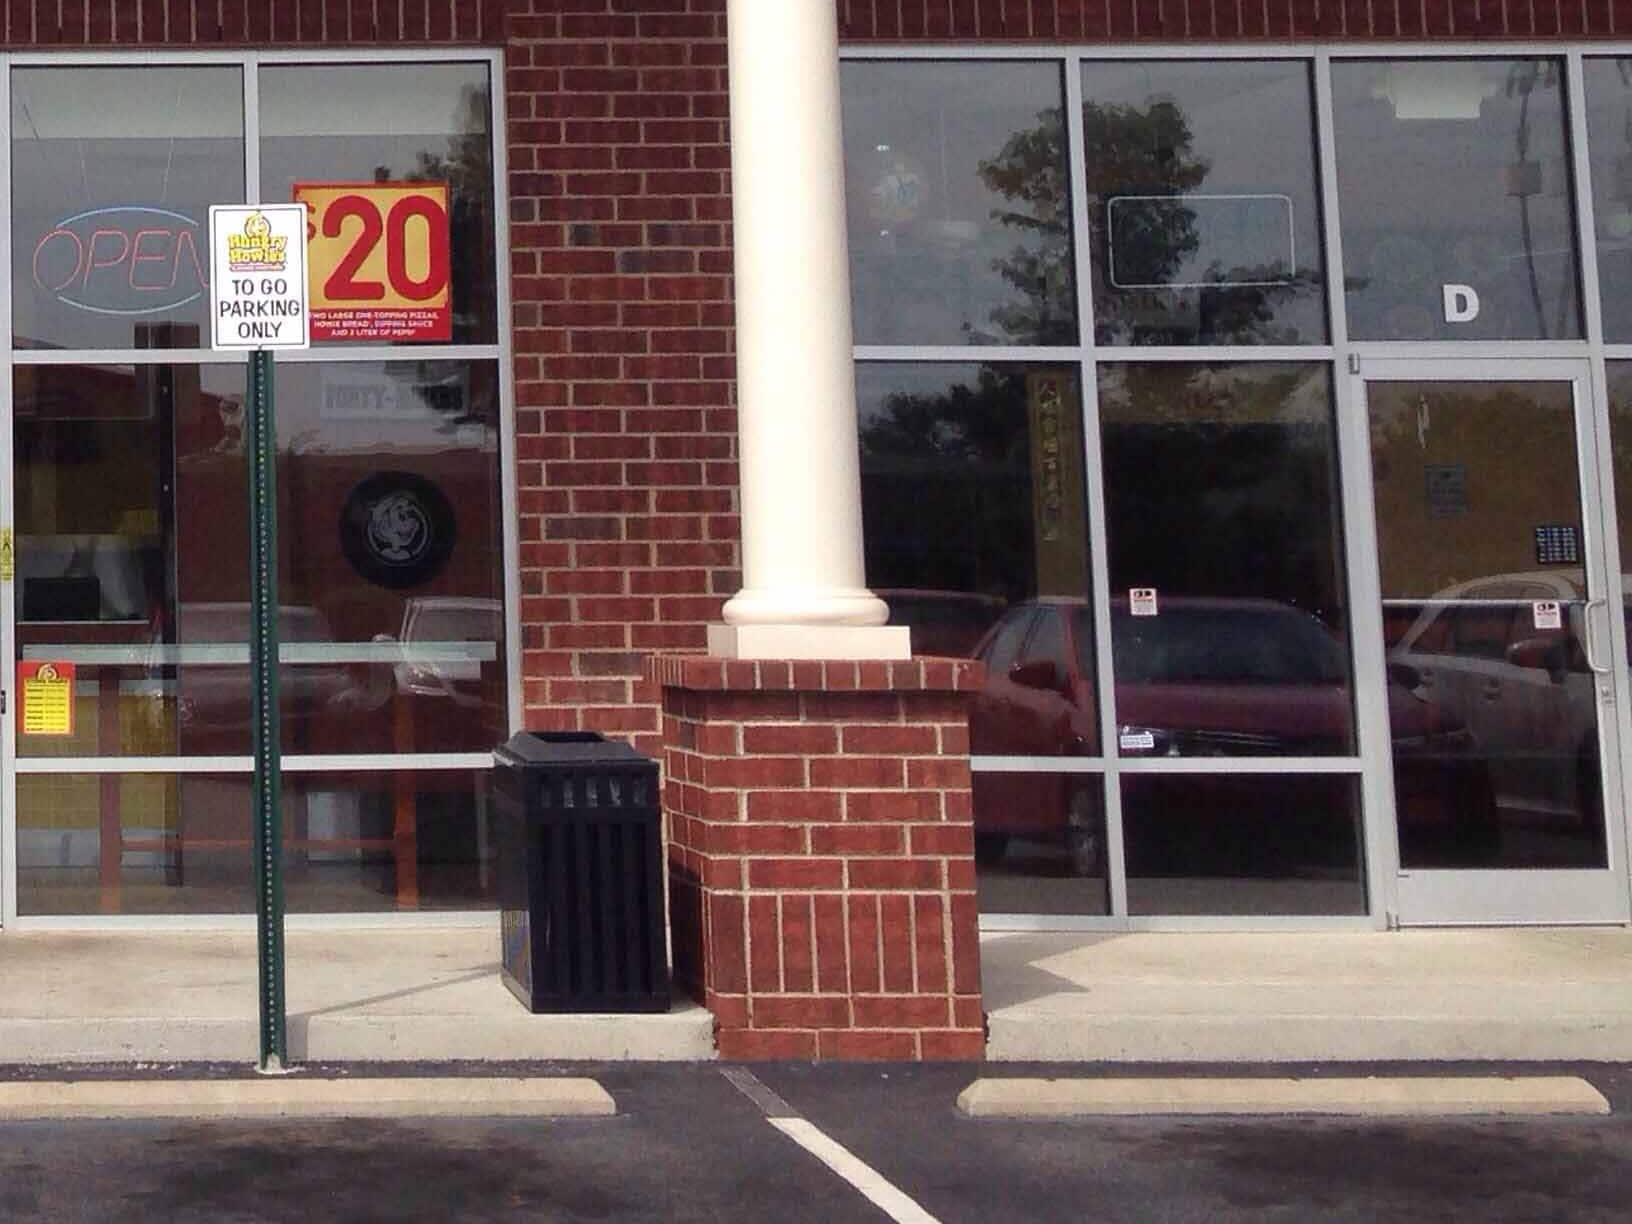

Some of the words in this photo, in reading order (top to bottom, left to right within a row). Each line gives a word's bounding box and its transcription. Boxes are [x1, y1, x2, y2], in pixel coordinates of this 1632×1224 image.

[231, 278, 254, 296] TO
[261, 278, 287, 295] GO
[220, 299, 300, 317] PARKING
[1442, 284, 1480, 322] D
[238, 321, 282, 338] ONLY
